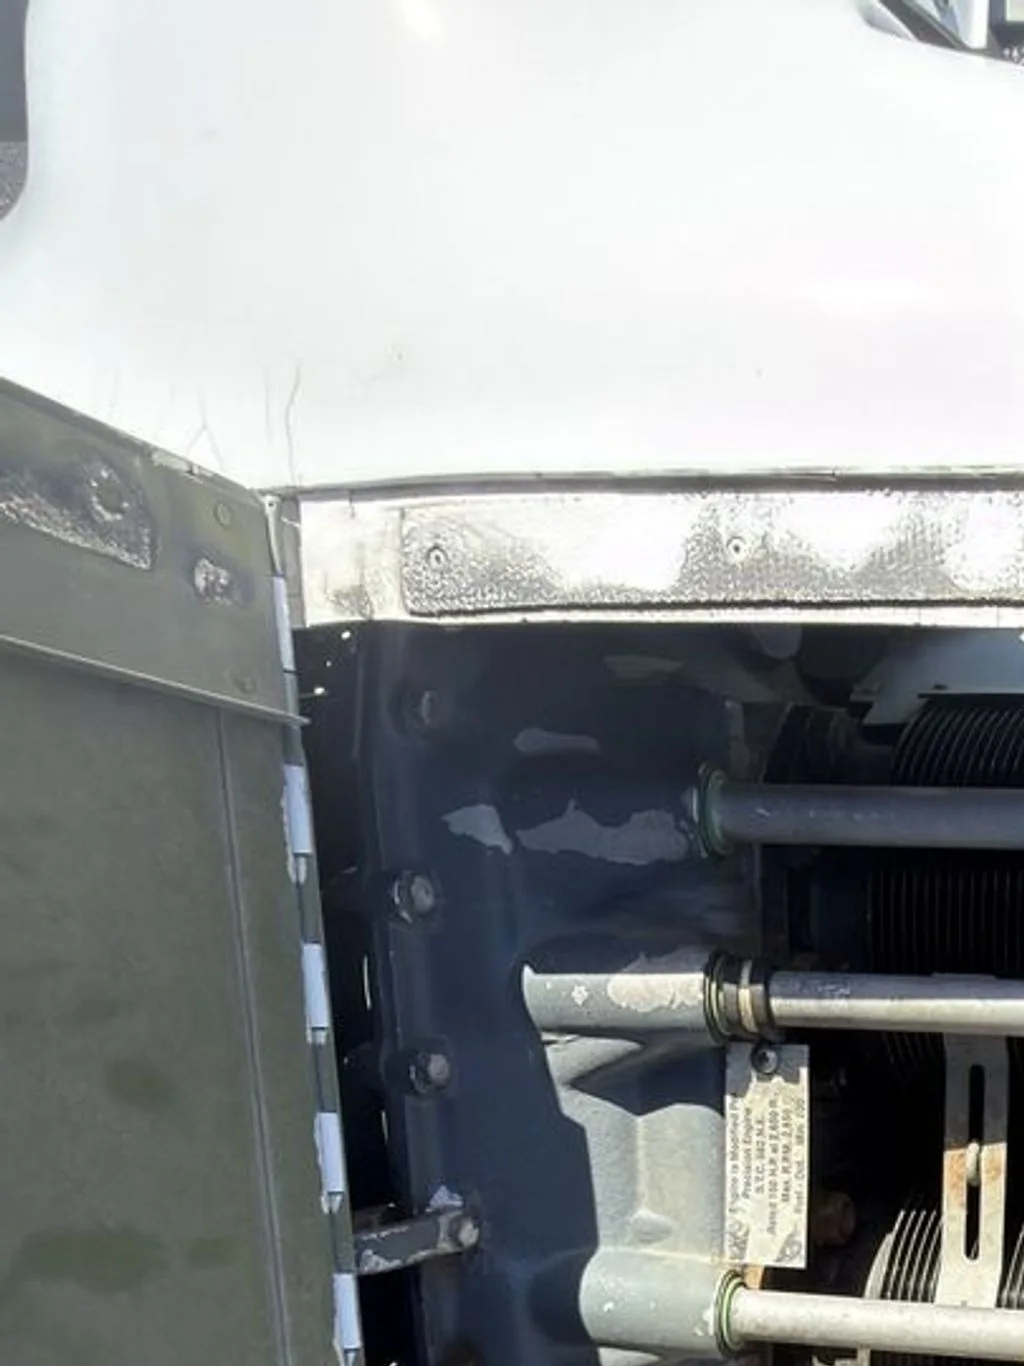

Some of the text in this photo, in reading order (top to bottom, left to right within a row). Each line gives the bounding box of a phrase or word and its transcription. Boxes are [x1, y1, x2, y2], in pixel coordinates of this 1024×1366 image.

[728, 1112, 740, 1163] Modified
[741, 1107, 754, 1200] Precision Engine
